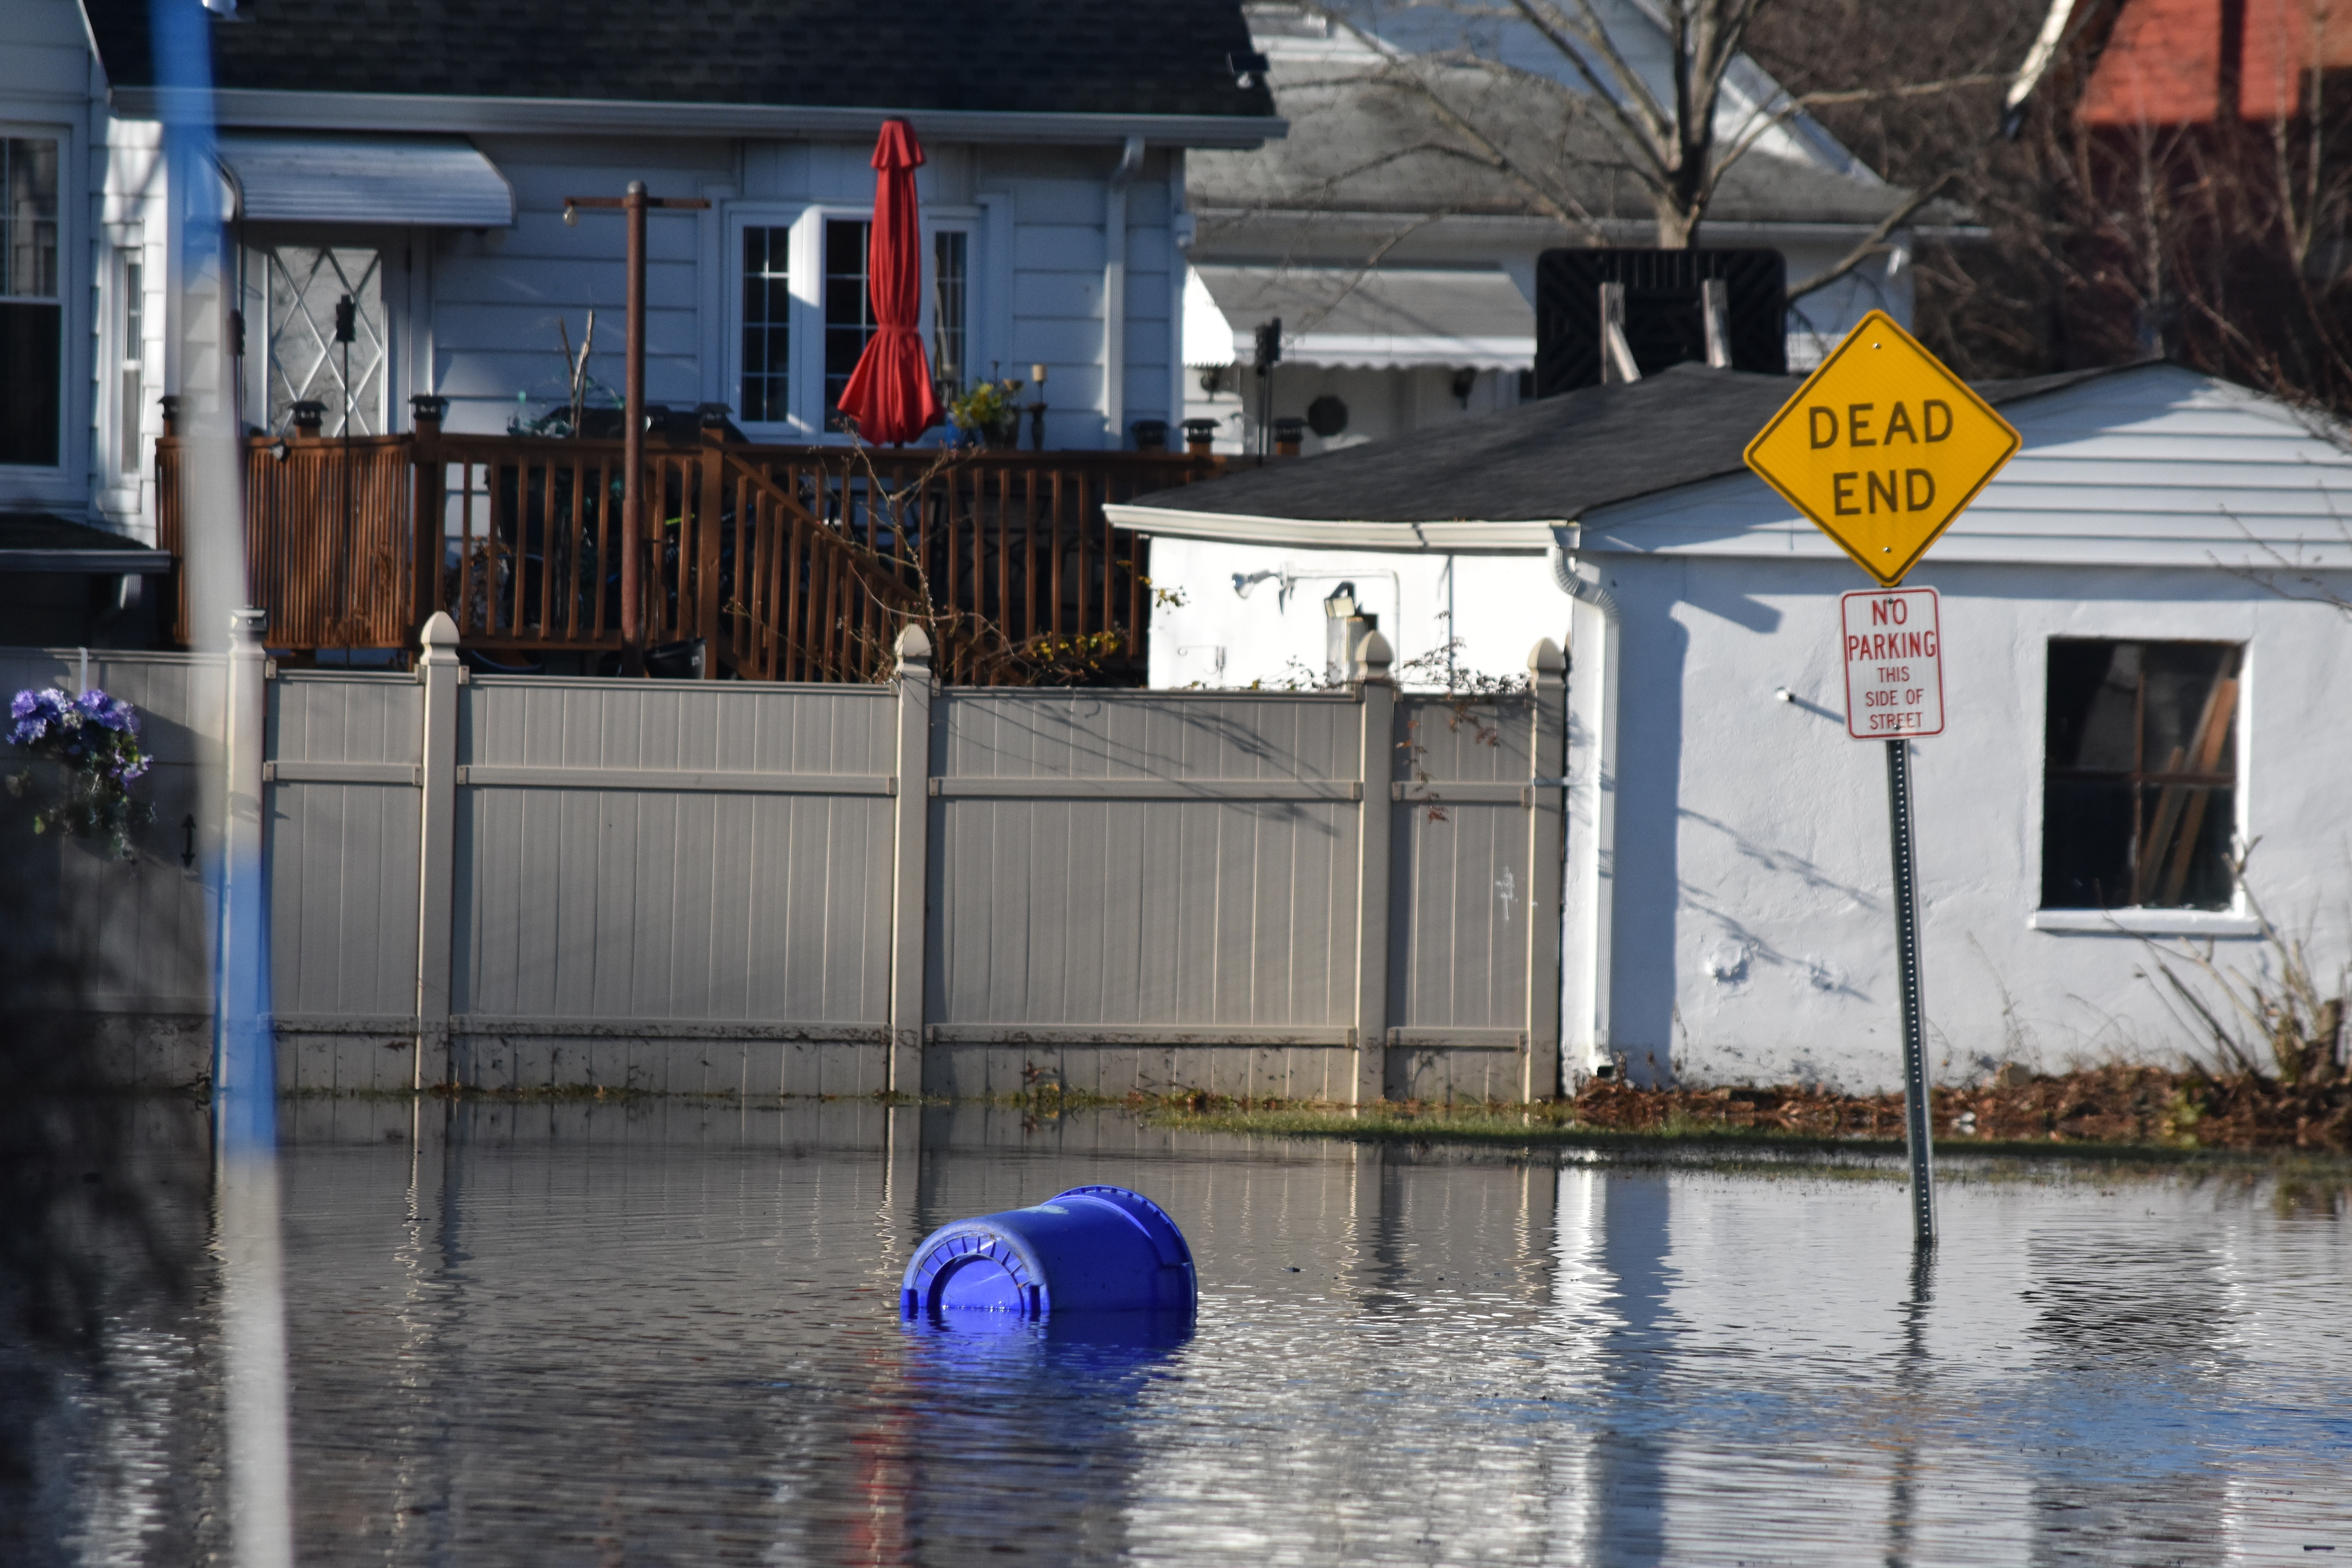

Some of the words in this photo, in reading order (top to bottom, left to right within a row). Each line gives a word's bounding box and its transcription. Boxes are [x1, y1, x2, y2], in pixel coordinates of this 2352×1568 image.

[1809, 399, 1953, 450] DEAD
[1833, 468, 1935, 516] END
[1872, 598, 1908, 626] NO
[1848, 630, 1937, 661] PARKING
[1878, 666, 1910, 683] THIS
[1866, 690, 1898, 707] SIDE
[1906, 688, 1924, 705] OF
[1870, 712, 1923, 730] STREET
